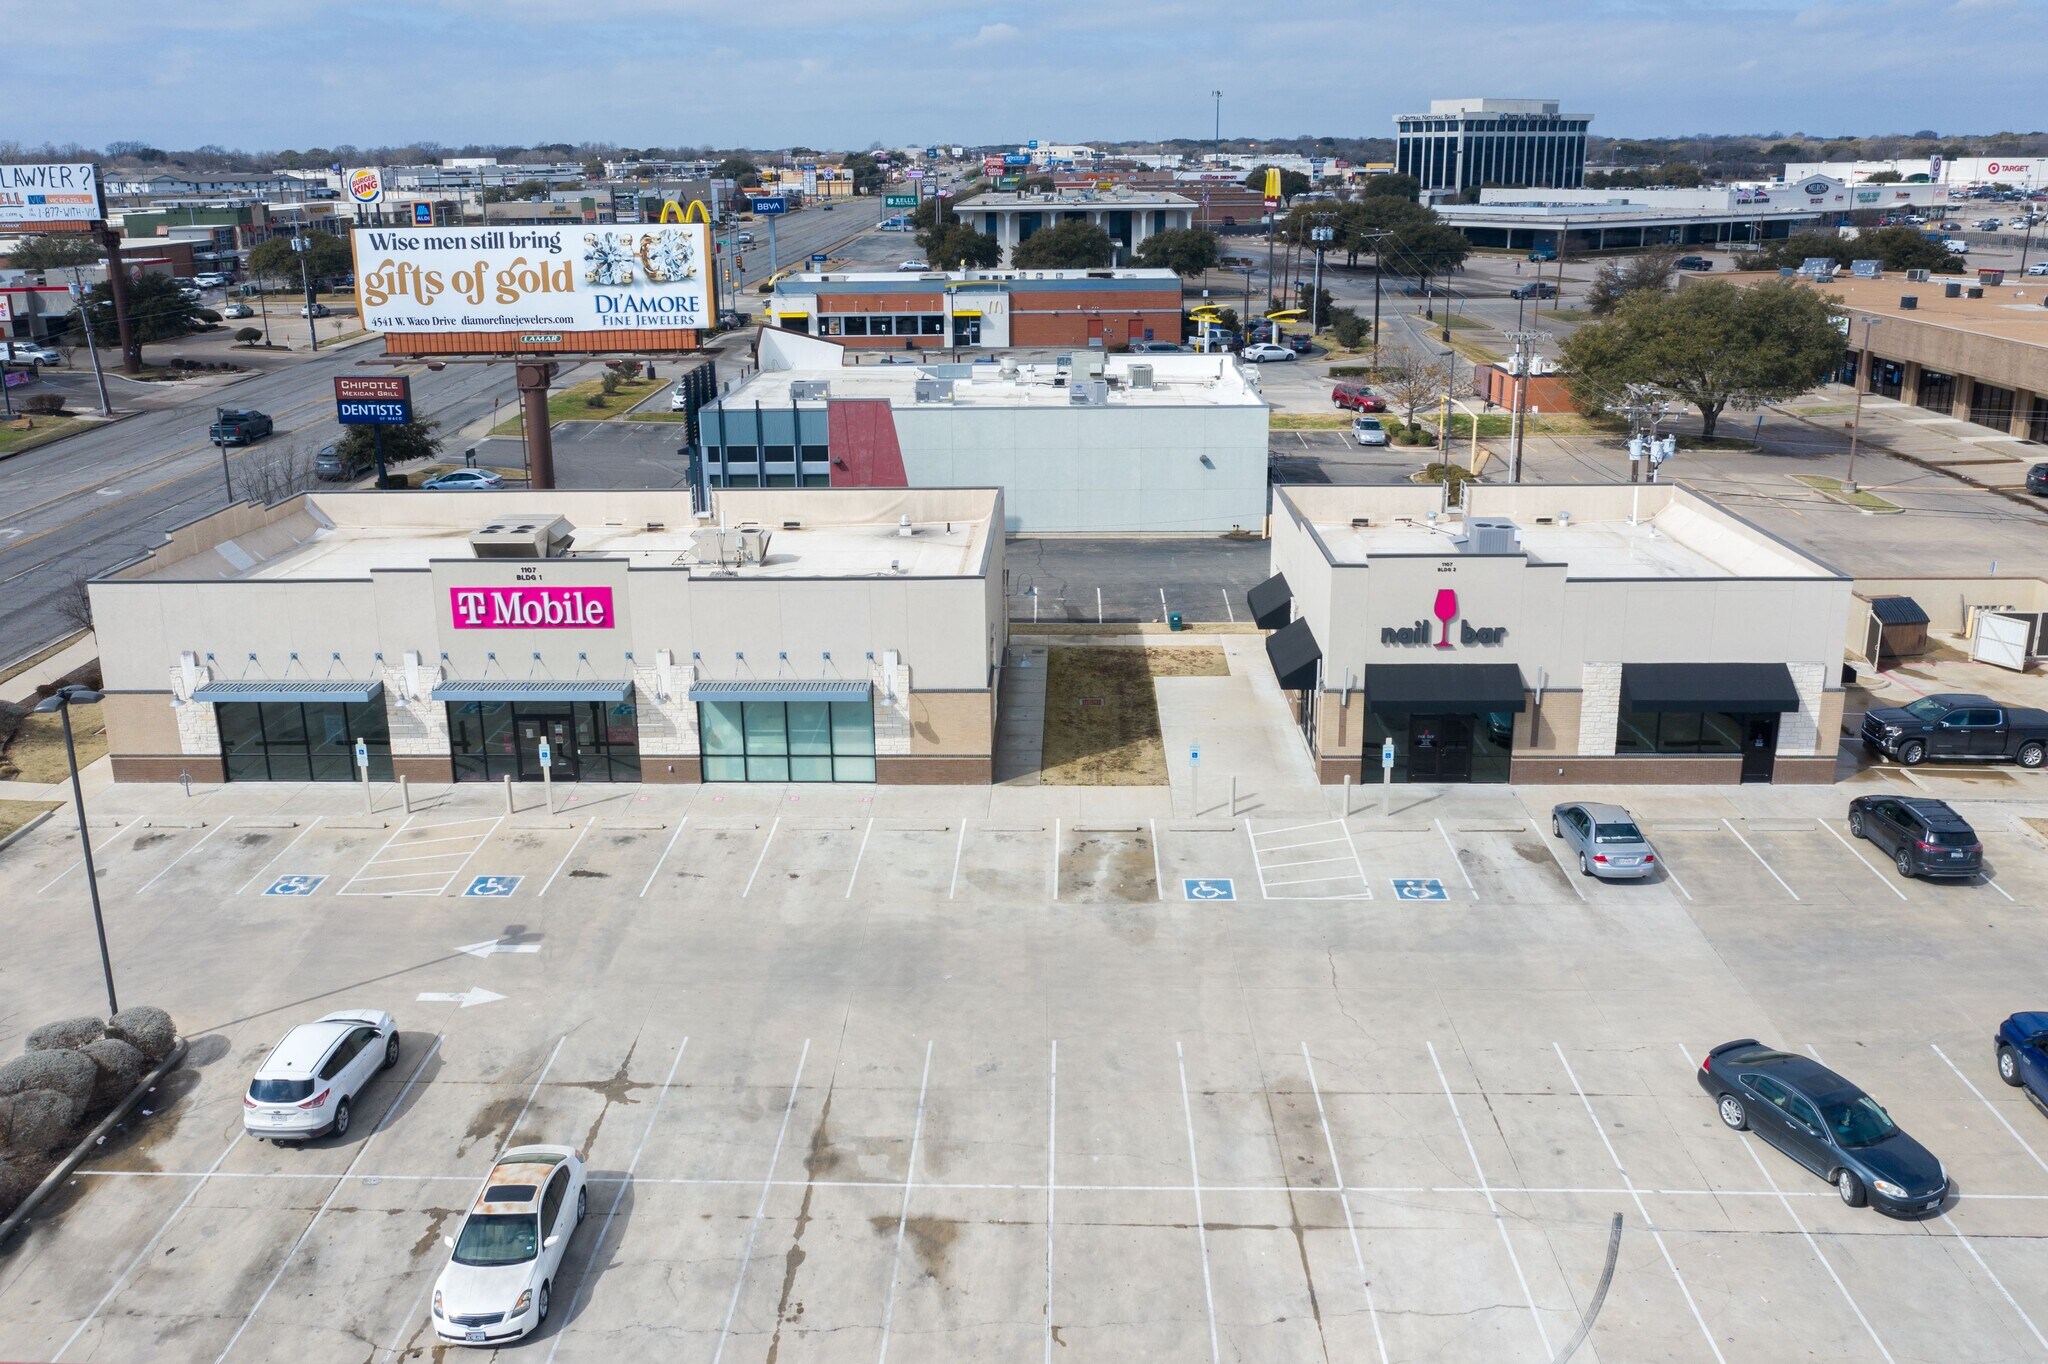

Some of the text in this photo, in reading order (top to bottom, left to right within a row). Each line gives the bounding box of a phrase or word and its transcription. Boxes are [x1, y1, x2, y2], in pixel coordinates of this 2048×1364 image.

[352, 174, 376, 188] BURGER
[353, 181, 378, 195] KING
[757, 202, 780, 211] BBVA
[368, 231, 562, 254] Wise men still bring
[365, 256, 576, 307] gifts of gold
[372, 314, 574, 327] 4541 W. Waco Drive diamorefinejewelers.com
[602, 314, 695, 328] FINE JEWELERS
[341, 380, 399, 389] CHIPOTLE
[341, 404, 403, 416] DENTISTS
[1381, 619, 1507, 644] nail bar
